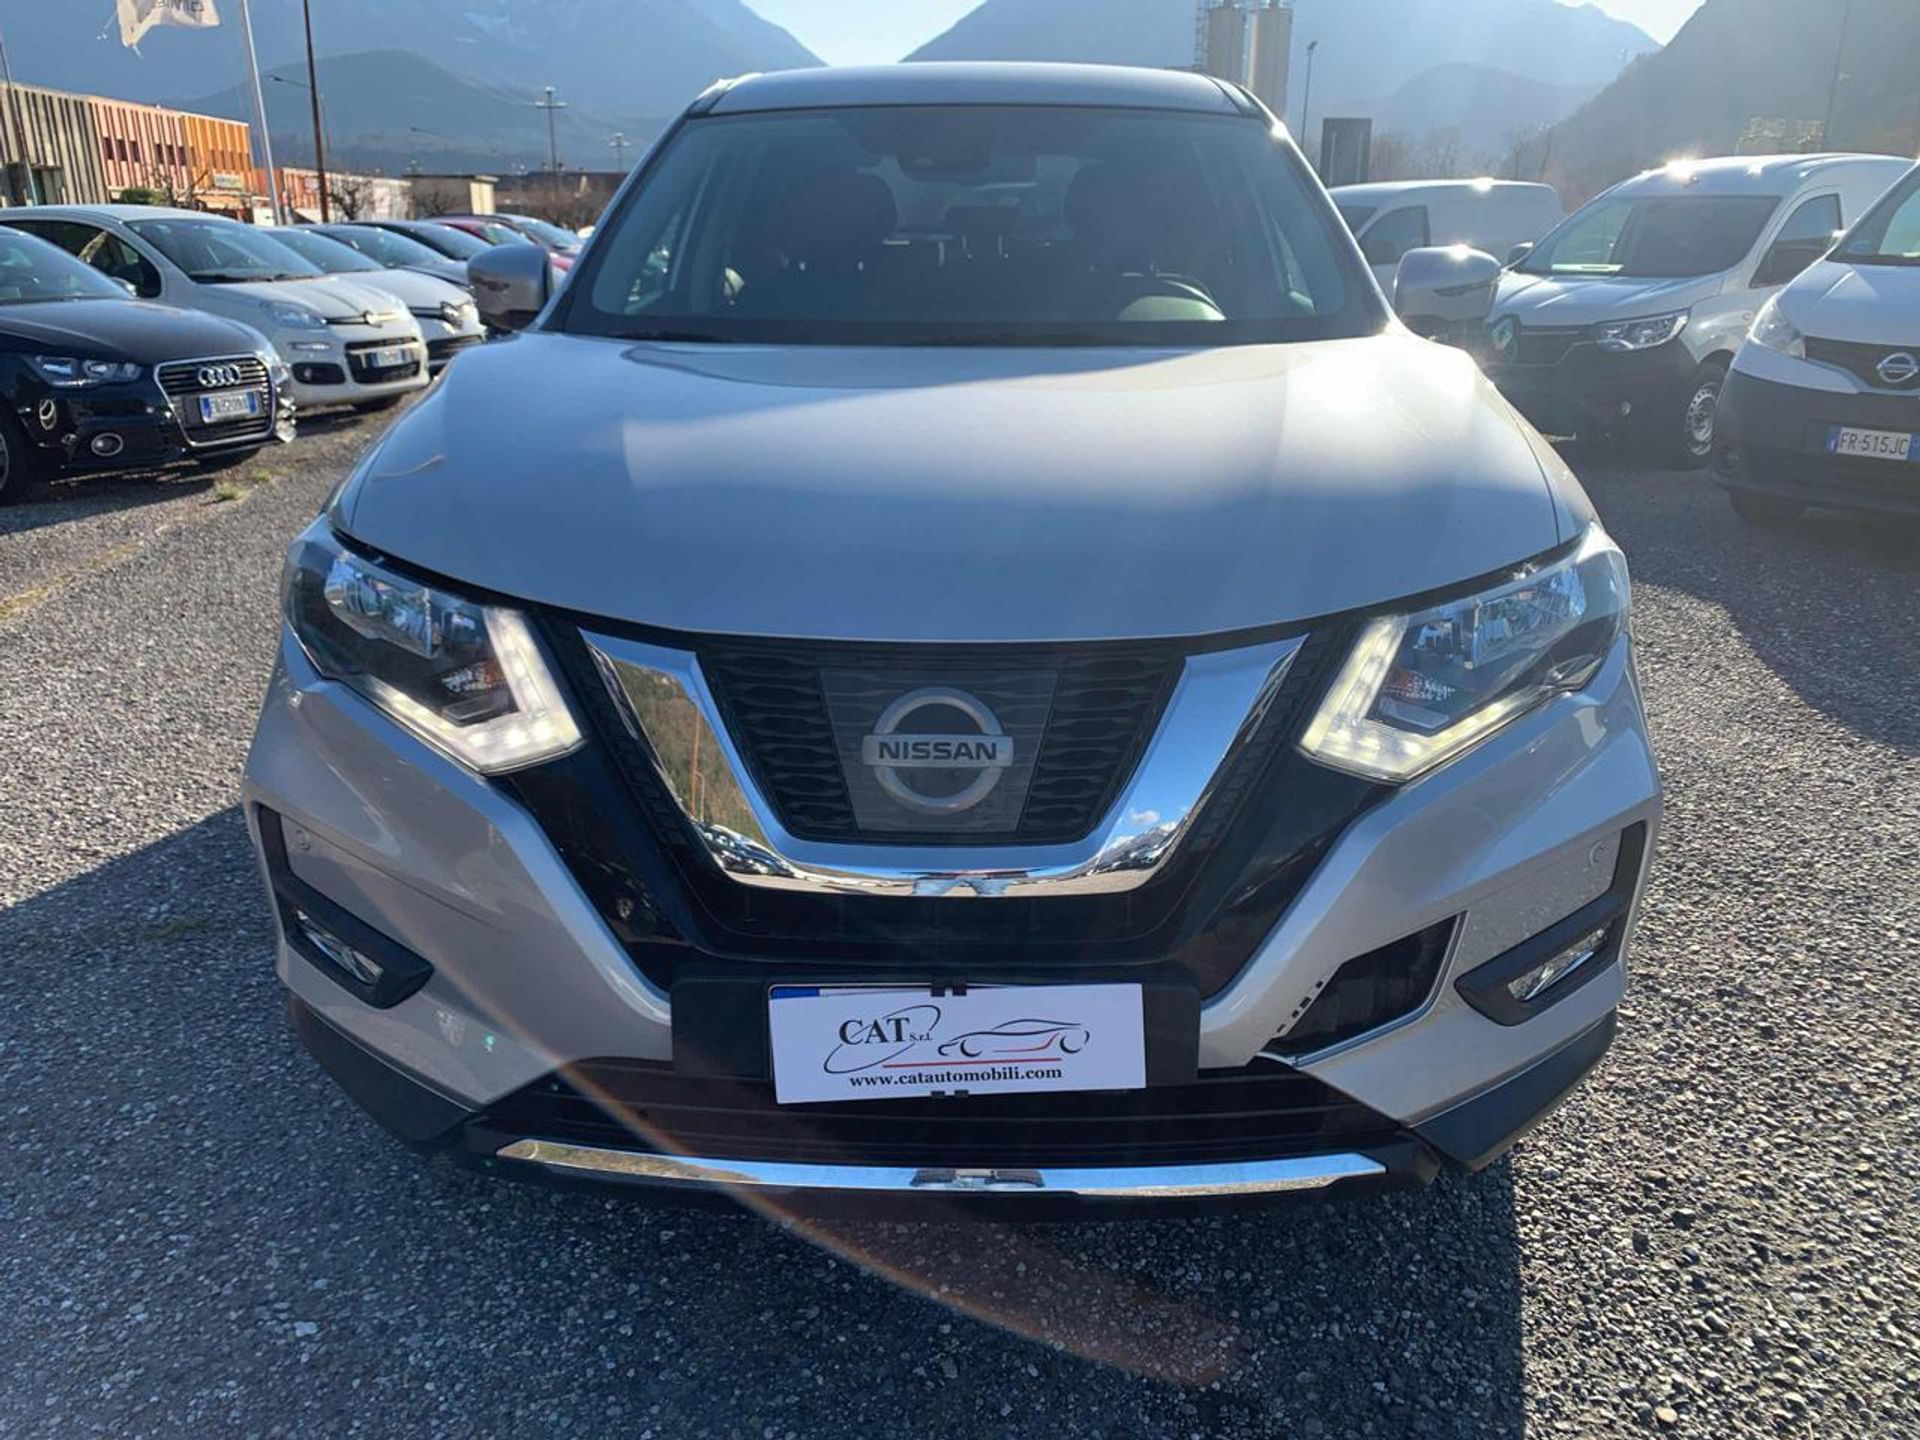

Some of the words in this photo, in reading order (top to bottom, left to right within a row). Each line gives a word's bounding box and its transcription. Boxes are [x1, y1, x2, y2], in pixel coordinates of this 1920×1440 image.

[878, 741, 997, 761] NISSAN
[839, 1017, 910, 1045] CAT
[849, 1066, 1062, 1087] www.catautomobili.com
